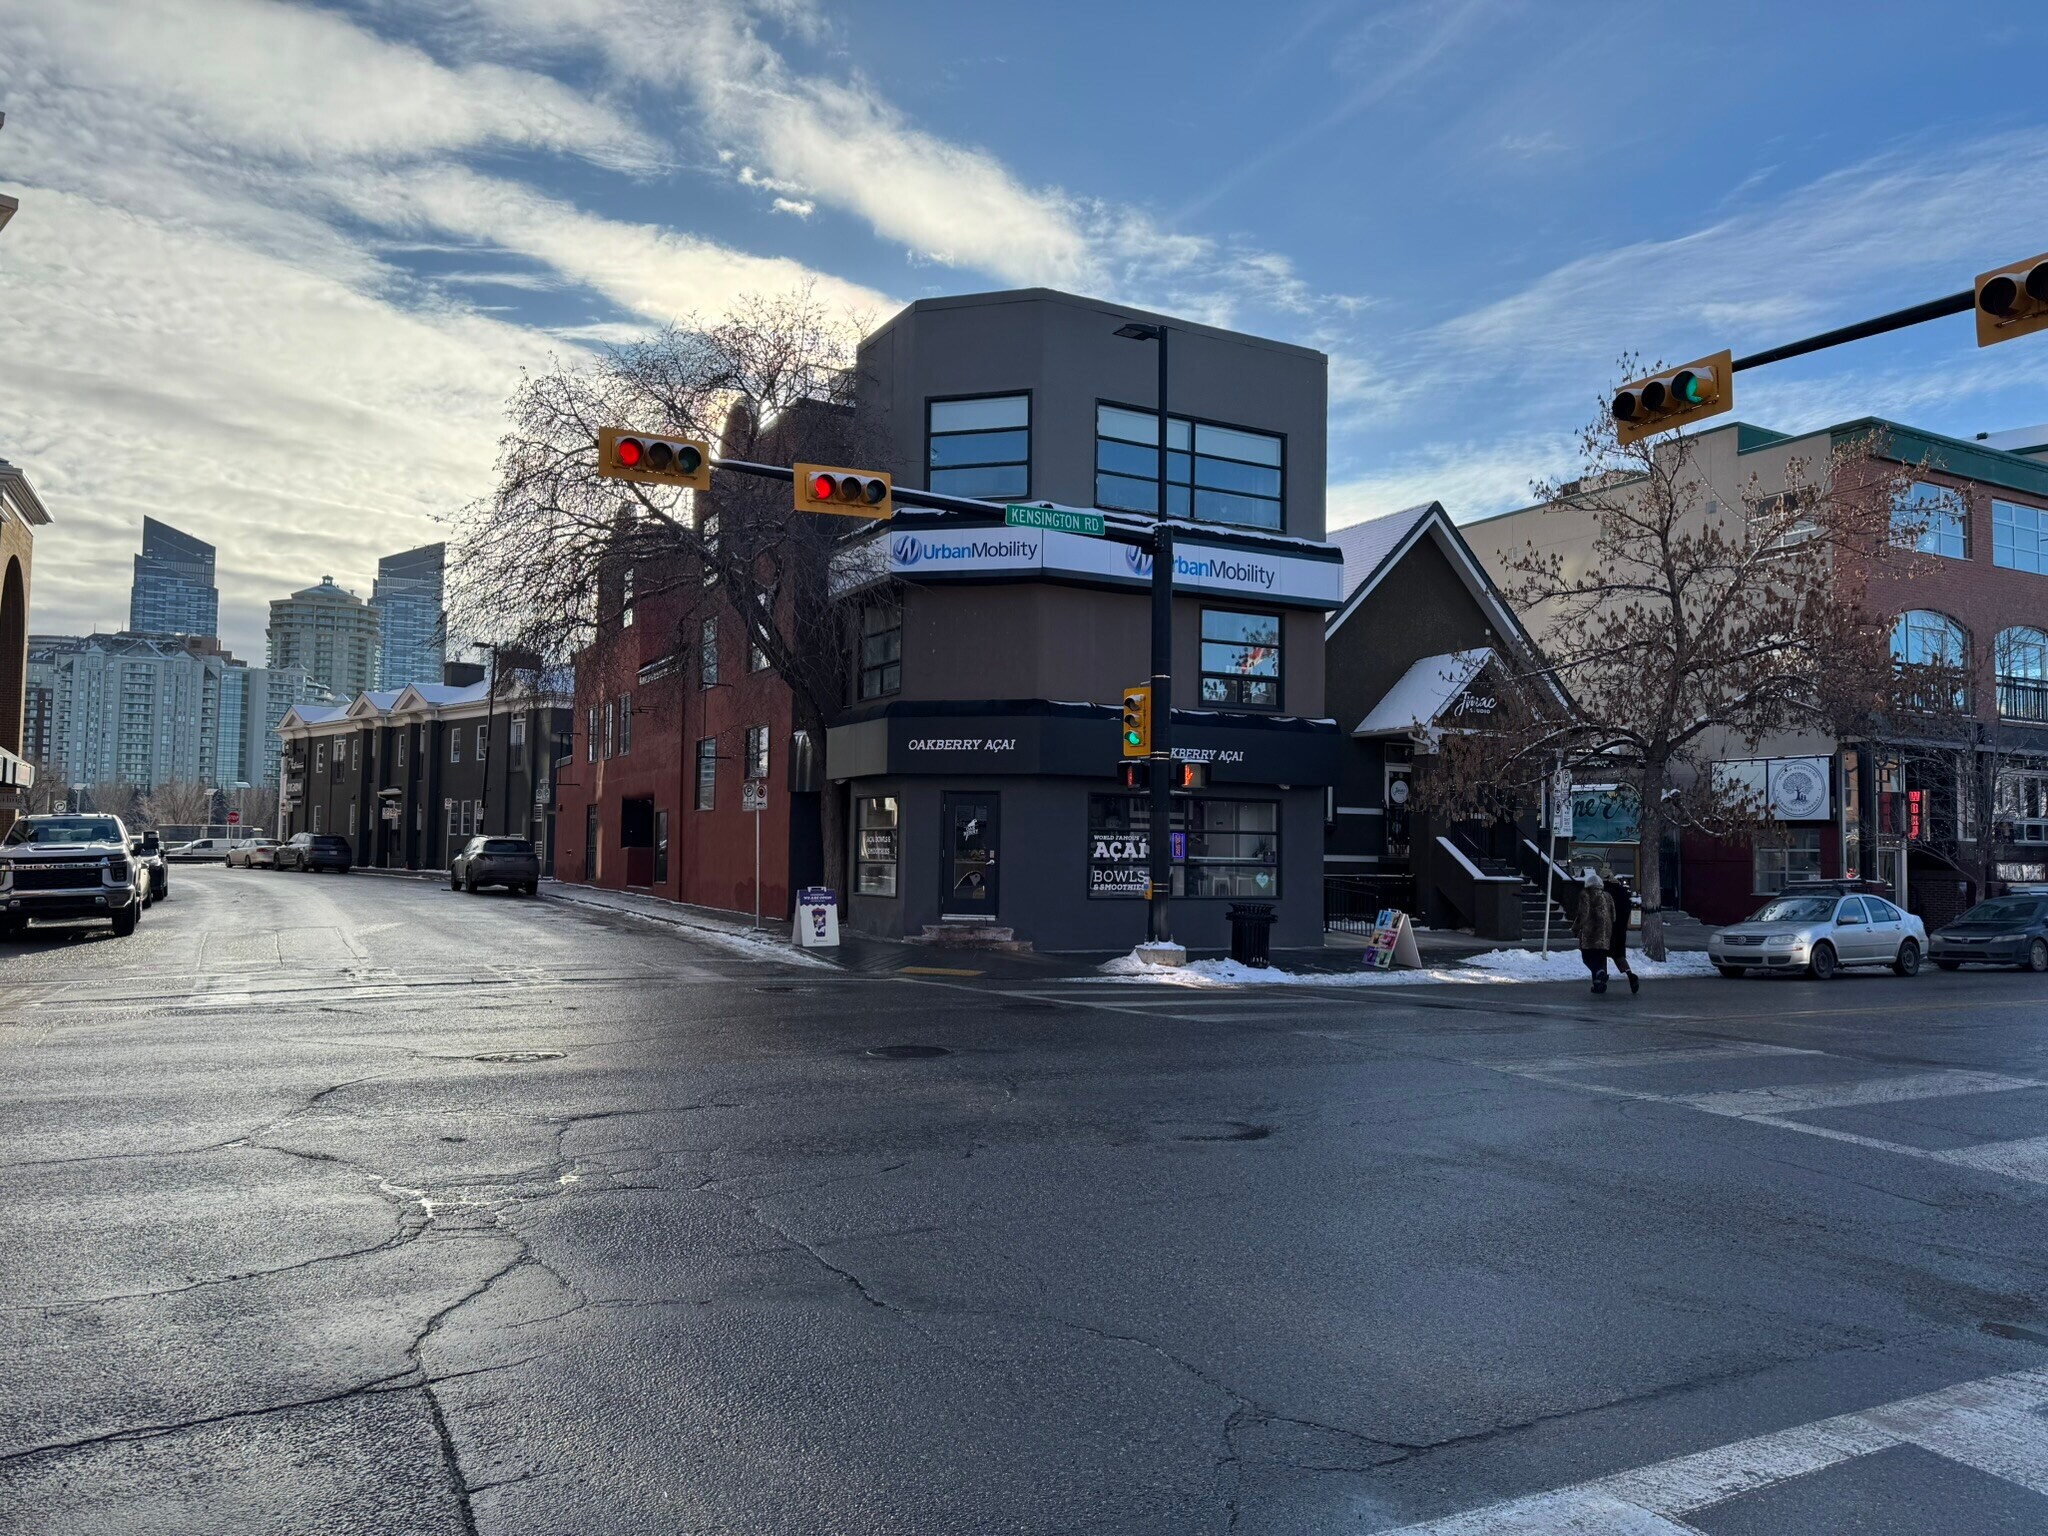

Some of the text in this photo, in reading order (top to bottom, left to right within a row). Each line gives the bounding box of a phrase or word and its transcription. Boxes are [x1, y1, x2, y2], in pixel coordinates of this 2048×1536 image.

[1011, 508, 1099, 532] KENSINGTON RD
[923, 541, 1038, 561] UrbanMobility
[1172, 555, 1275, 588] rbanMobility
[908, 739, 1016, 753] OAKBERRY AÇAI
[1170, 747, 1244, 764] KBERRY AÇAI
[1573, 795, 1622, 819] ner
[1093, 838, 1147, 862] AÇAÍ
[1093, 870, 1146, 883] BOWLS
[1093, 883, 1099, 891] &
